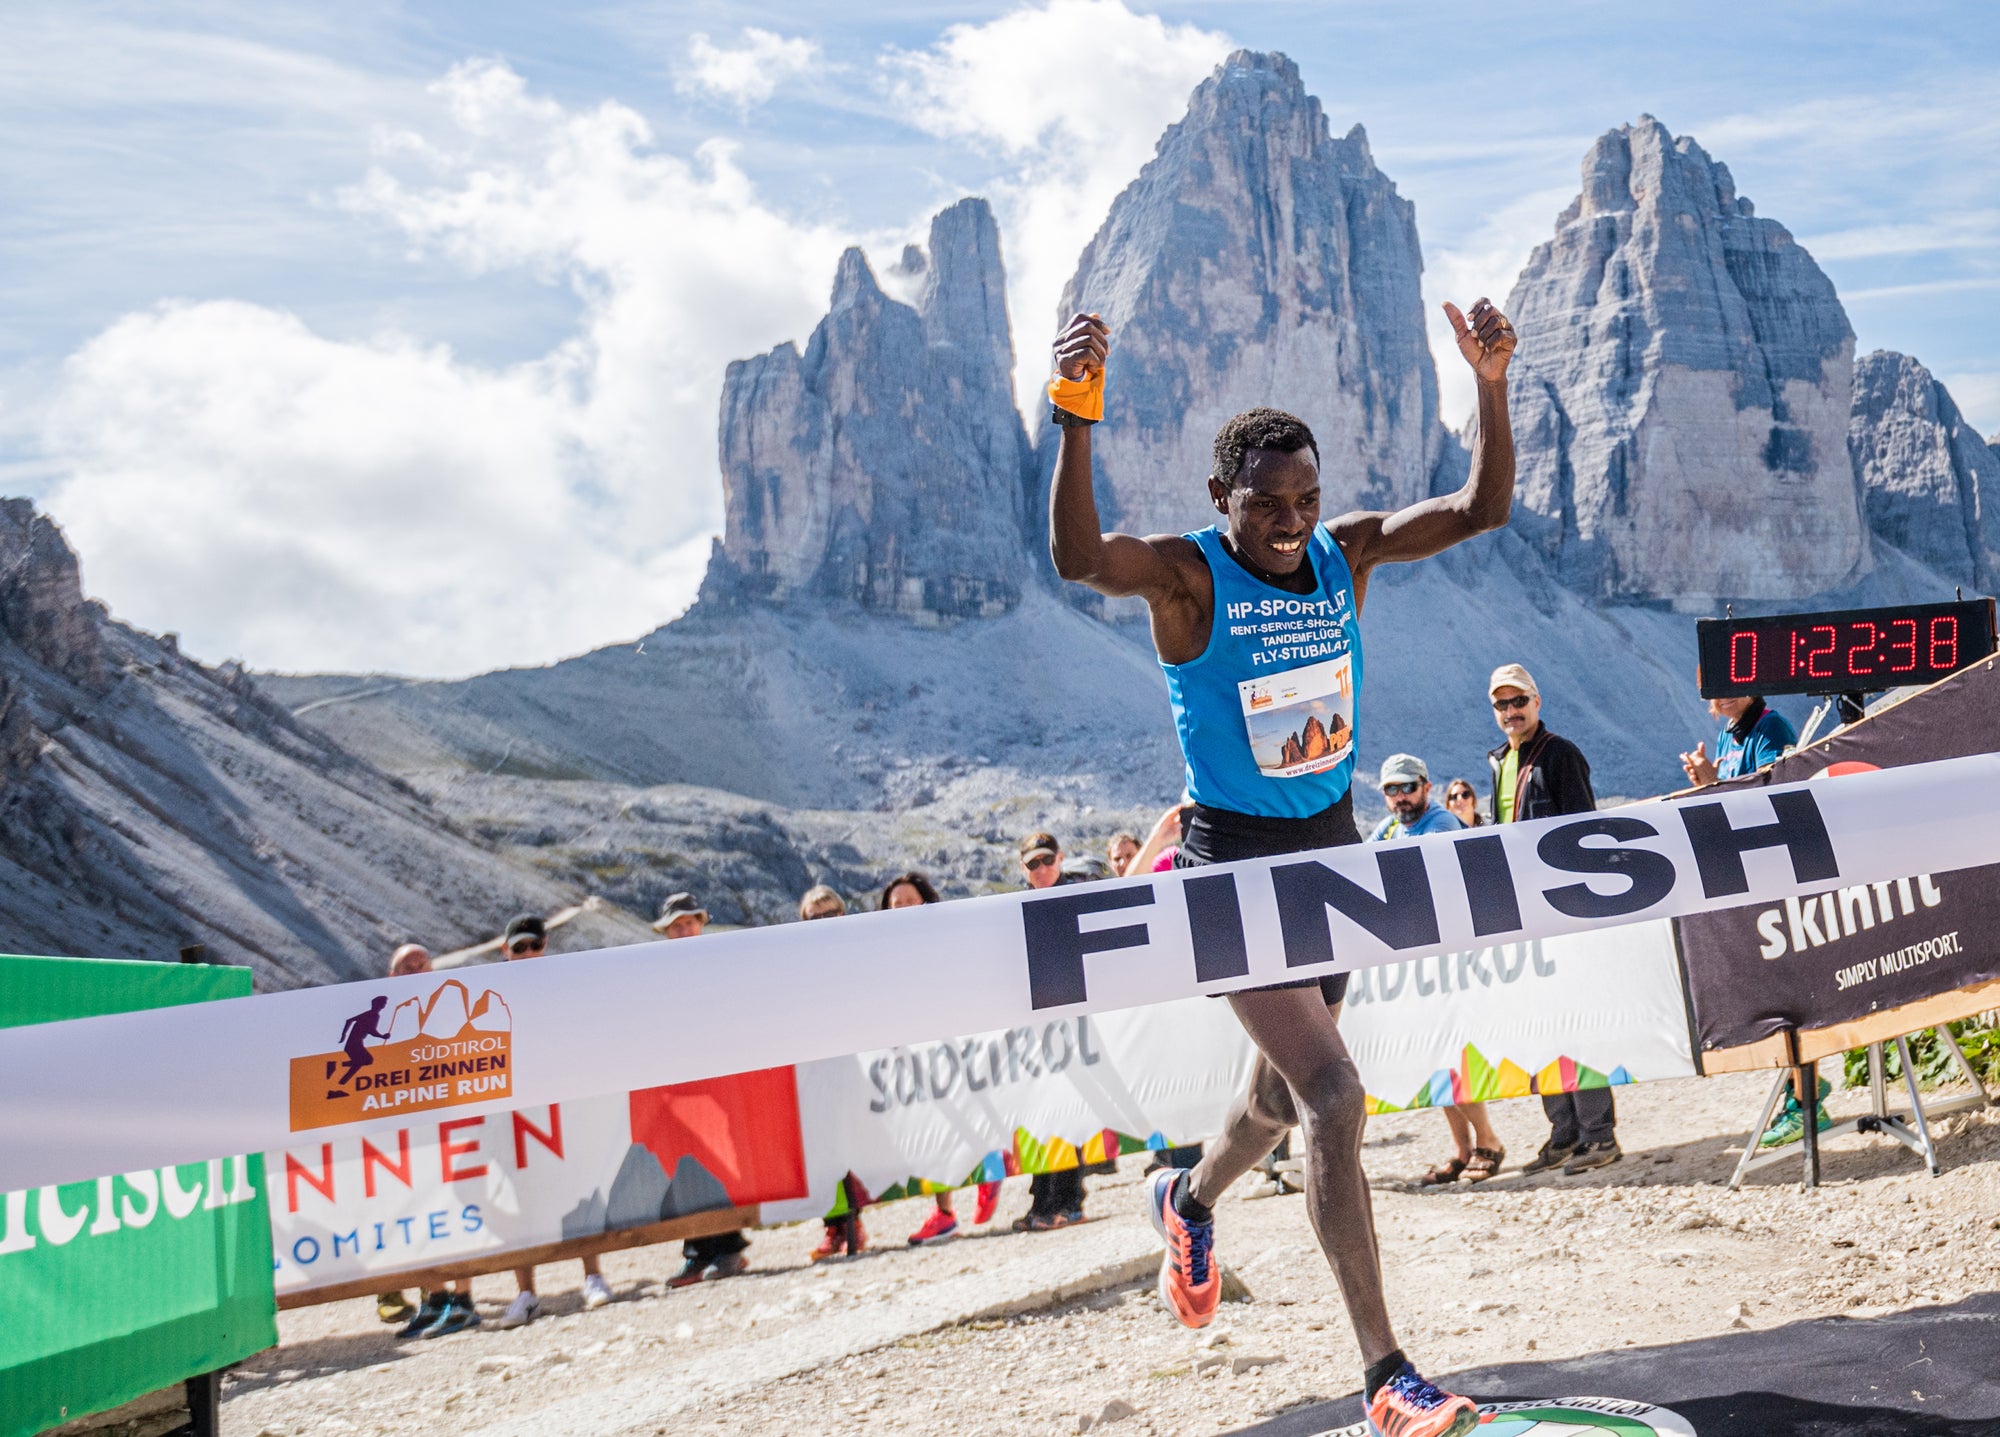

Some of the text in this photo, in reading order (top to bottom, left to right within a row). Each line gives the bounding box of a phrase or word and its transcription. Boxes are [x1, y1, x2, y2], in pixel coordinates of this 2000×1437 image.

[1227, 589, 1346, 619] HP-SPORTS.AT
[1252, 640, 1350, 665] FLY-STUBAI.AT
[1262, 628, 1342, 647] TANDEMFLÜGE
[1335, 665, 1349, 699] 11
[1022, 789, 1840, 1011] FINISH
[1835, 931, 1963, 991] SIMPLY MULTISPORT.
[410, 1036, 507, 1063] SÜDTIROL
[355, 1054, 506, 1091] DREI ZINNEN
[362, 1074, 507, 1111] ALPINE RUN
[272, 1204, 483, 1269] OMITES
